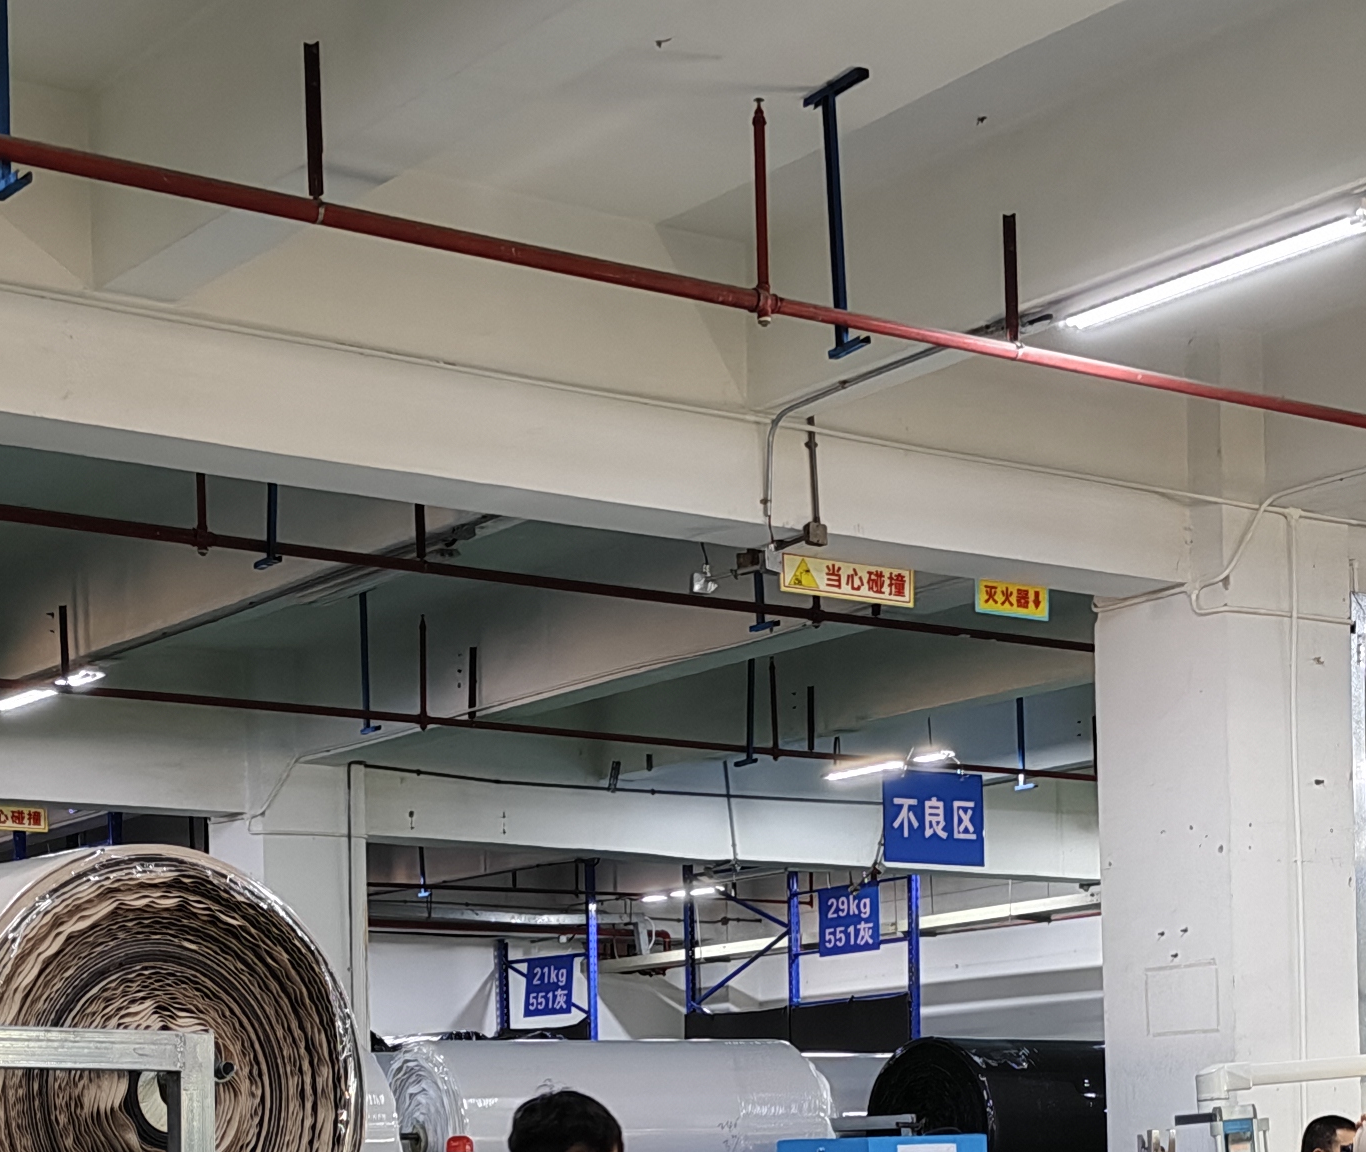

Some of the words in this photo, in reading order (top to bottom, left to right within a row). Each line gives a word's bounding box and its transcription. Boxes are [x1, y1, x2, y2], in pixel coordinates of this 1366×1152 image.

[825, 563, 906, 598] 当心碰撞
[983, 585, 1030, 609] 灭火器
[892, 796, 977, 840] 不良区
[827, 894, 871, 919] 29kg
[825, 920, 874, 948] 551灰
[532, 965, 567, 986] 21kg
[528, 988, 568, 1010] 551灰
